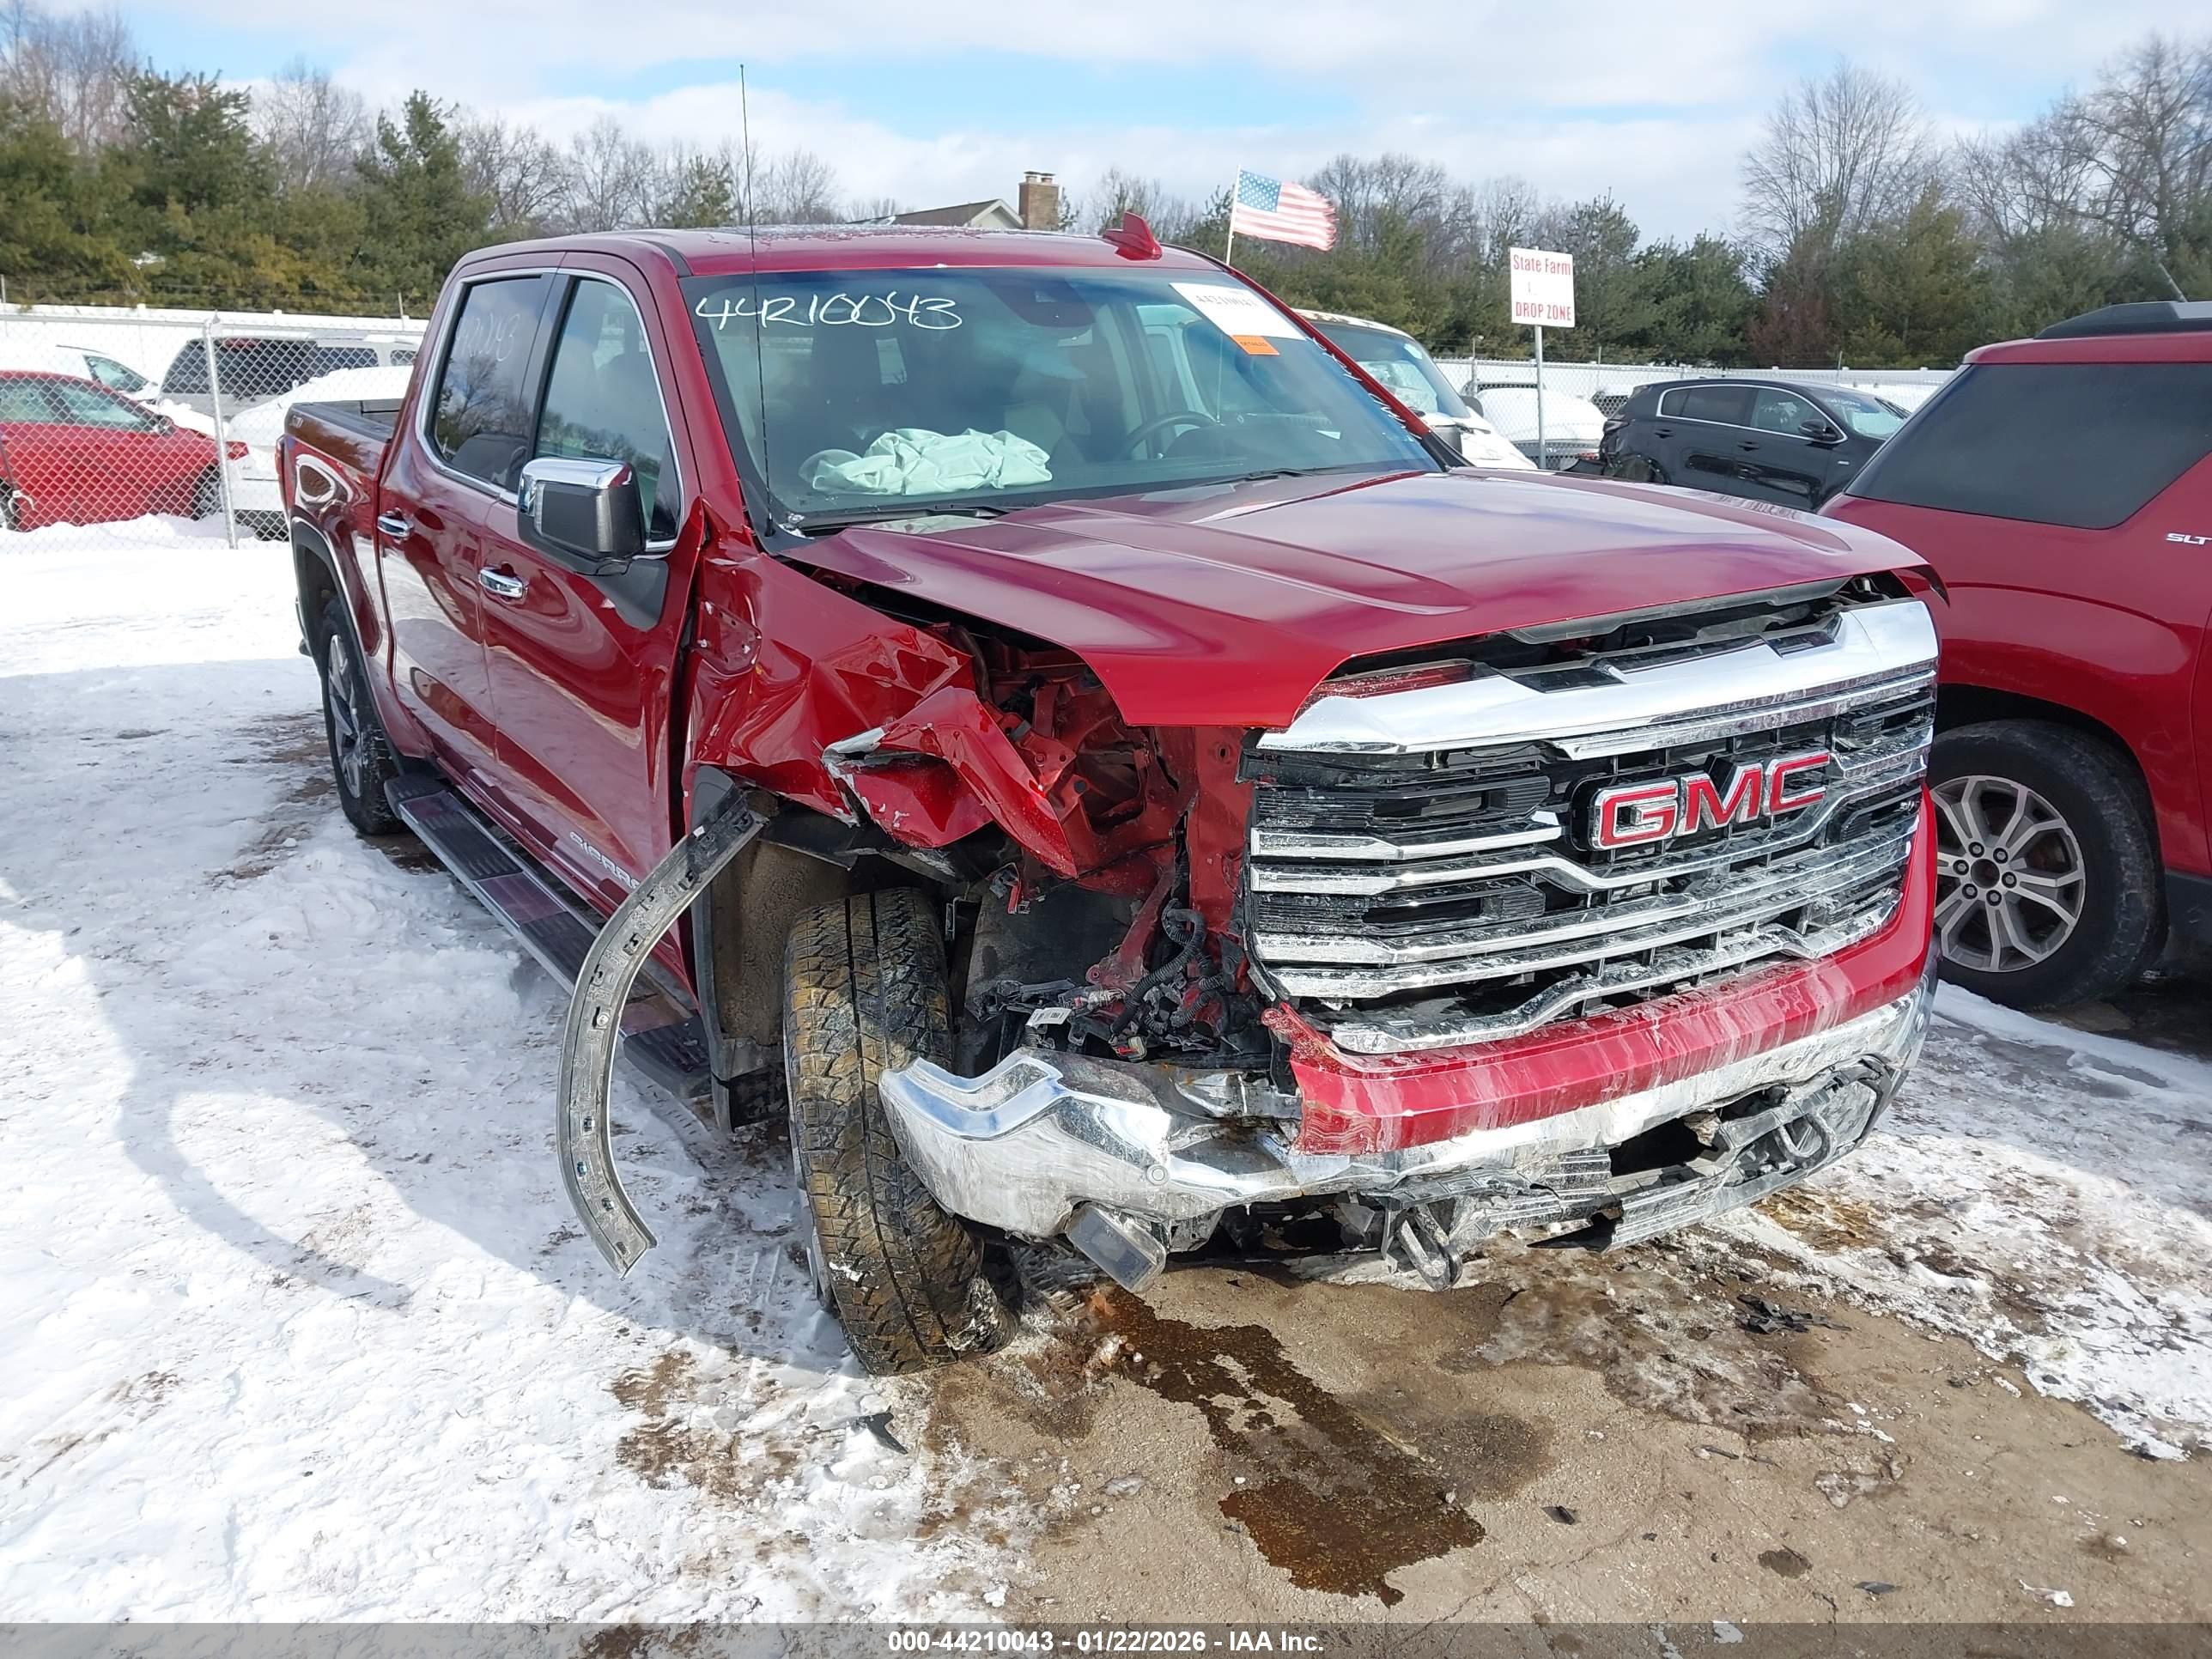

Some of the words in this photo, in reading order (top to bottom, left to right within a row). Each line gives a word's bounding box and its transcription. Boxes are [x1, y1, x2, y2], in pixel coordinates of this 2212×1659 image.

[1513, 254, 1541, 272] State
[1545, 258, 1571, 275] Farm
[1516, 301, 1544, 318] DROP
[1547, 304, 1571, 321] ZONE
[2166, 532, 2212, 545] SLT
[1591, 749, 1831, 850] GMC
